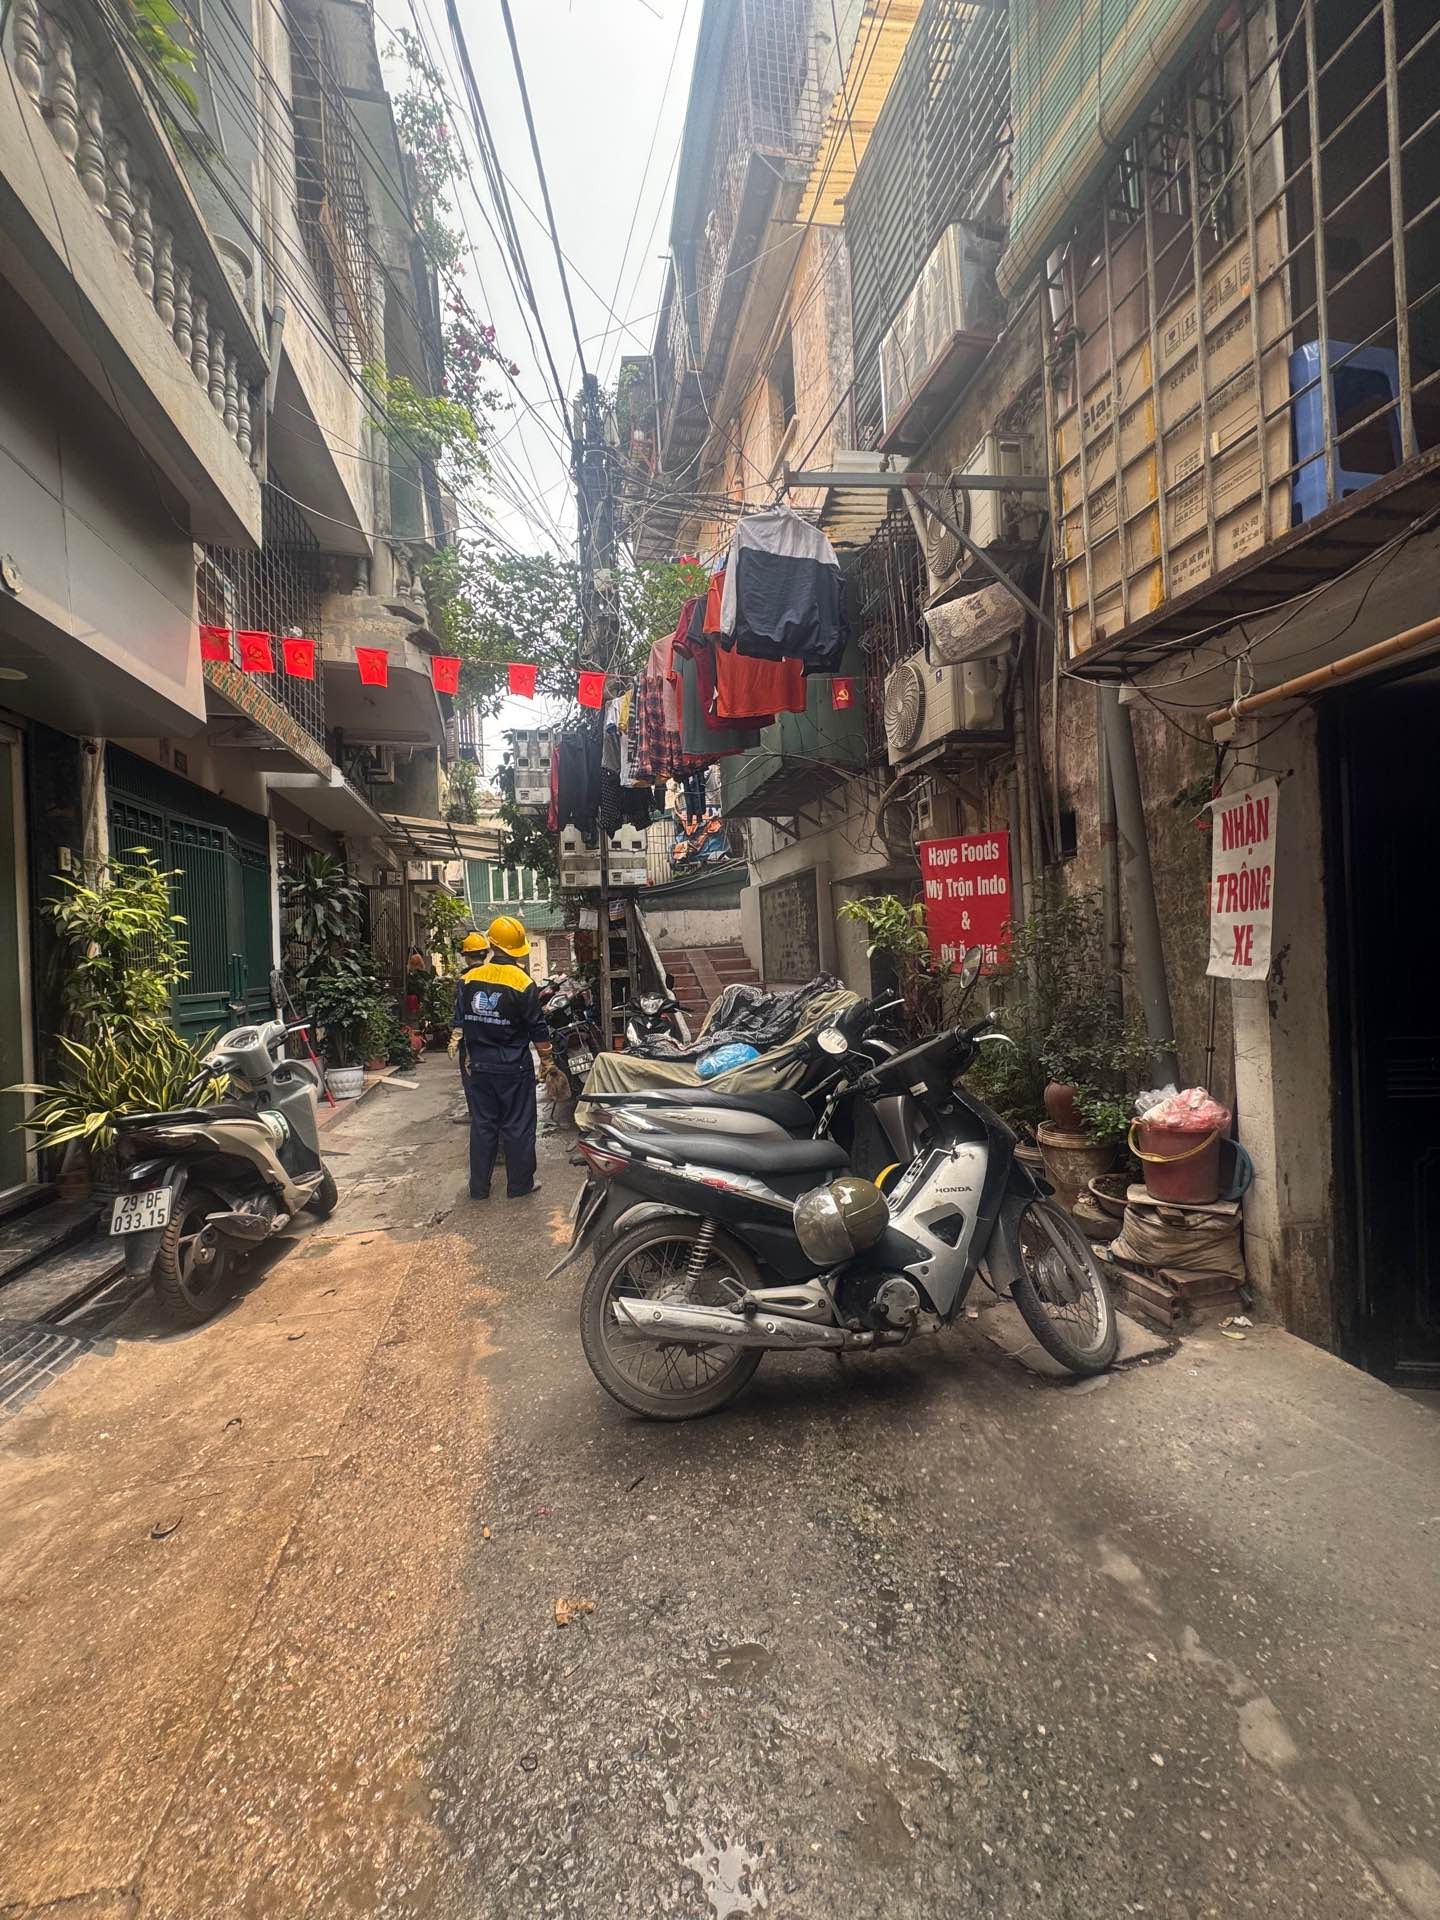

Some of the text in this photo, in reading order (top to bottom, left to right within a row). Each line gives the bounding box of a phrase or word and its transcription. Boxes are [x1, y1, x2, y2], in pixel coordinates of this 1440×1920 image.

[1221, 793, 1270, 855] NHẬN
[928, 840, 999, 867] Haye Foods
[945, 877, 973, 901] Trộn
[977, 874, 1006, 896] Indo
[1216, 861, 1271, 913] TRÔNG
[961, 911, 971, 930] &
[1231, 924, 1254, 966] XE
[121, 1191, 163, 1214] 29-BF
[113, 1208, 166, 1232] 033.15
